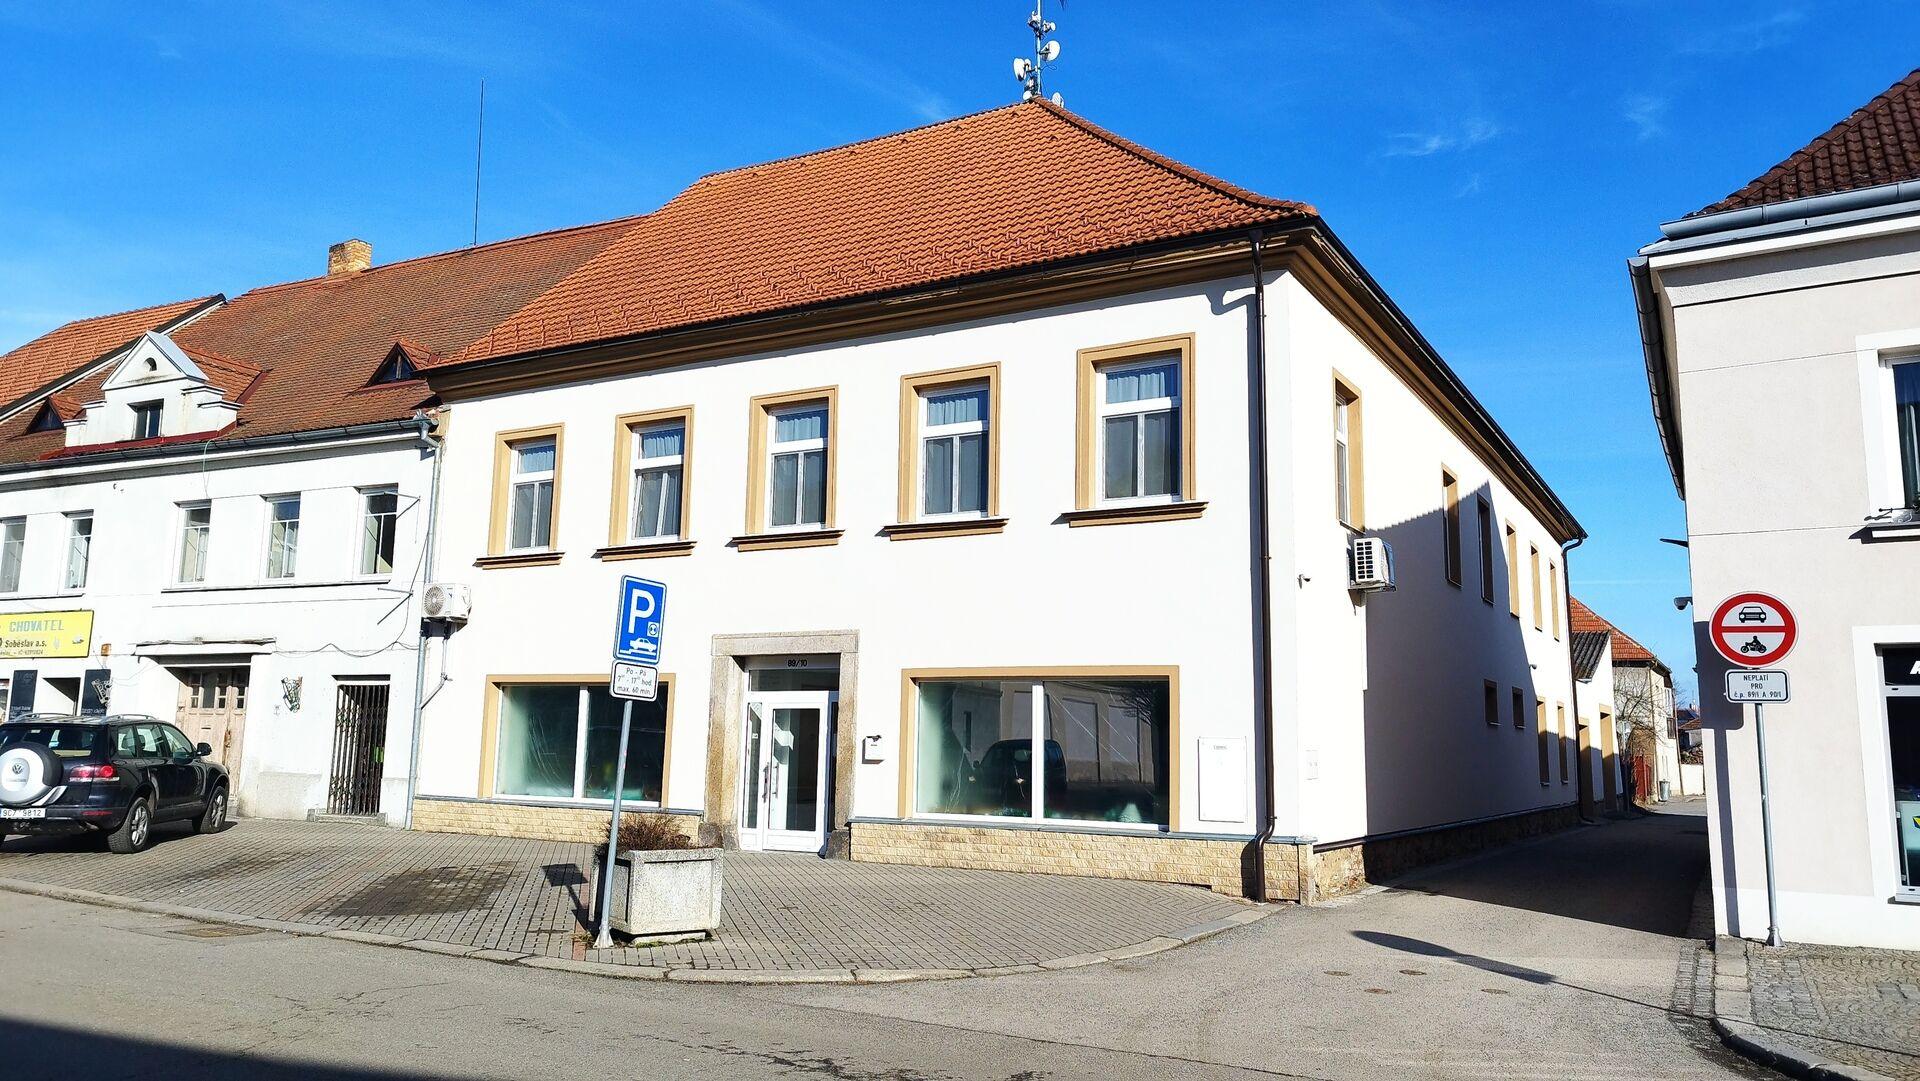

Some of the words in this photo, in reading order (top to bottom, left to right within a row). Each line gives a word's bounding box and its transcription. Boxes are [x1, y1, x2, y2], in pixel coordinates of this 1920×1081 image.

[628, 588, 656, 634] P
[9, 619, 65, 632] CHOVATEL
[787, 659, 808, 667] 89/10
[626, 667, 634, 675] Po
